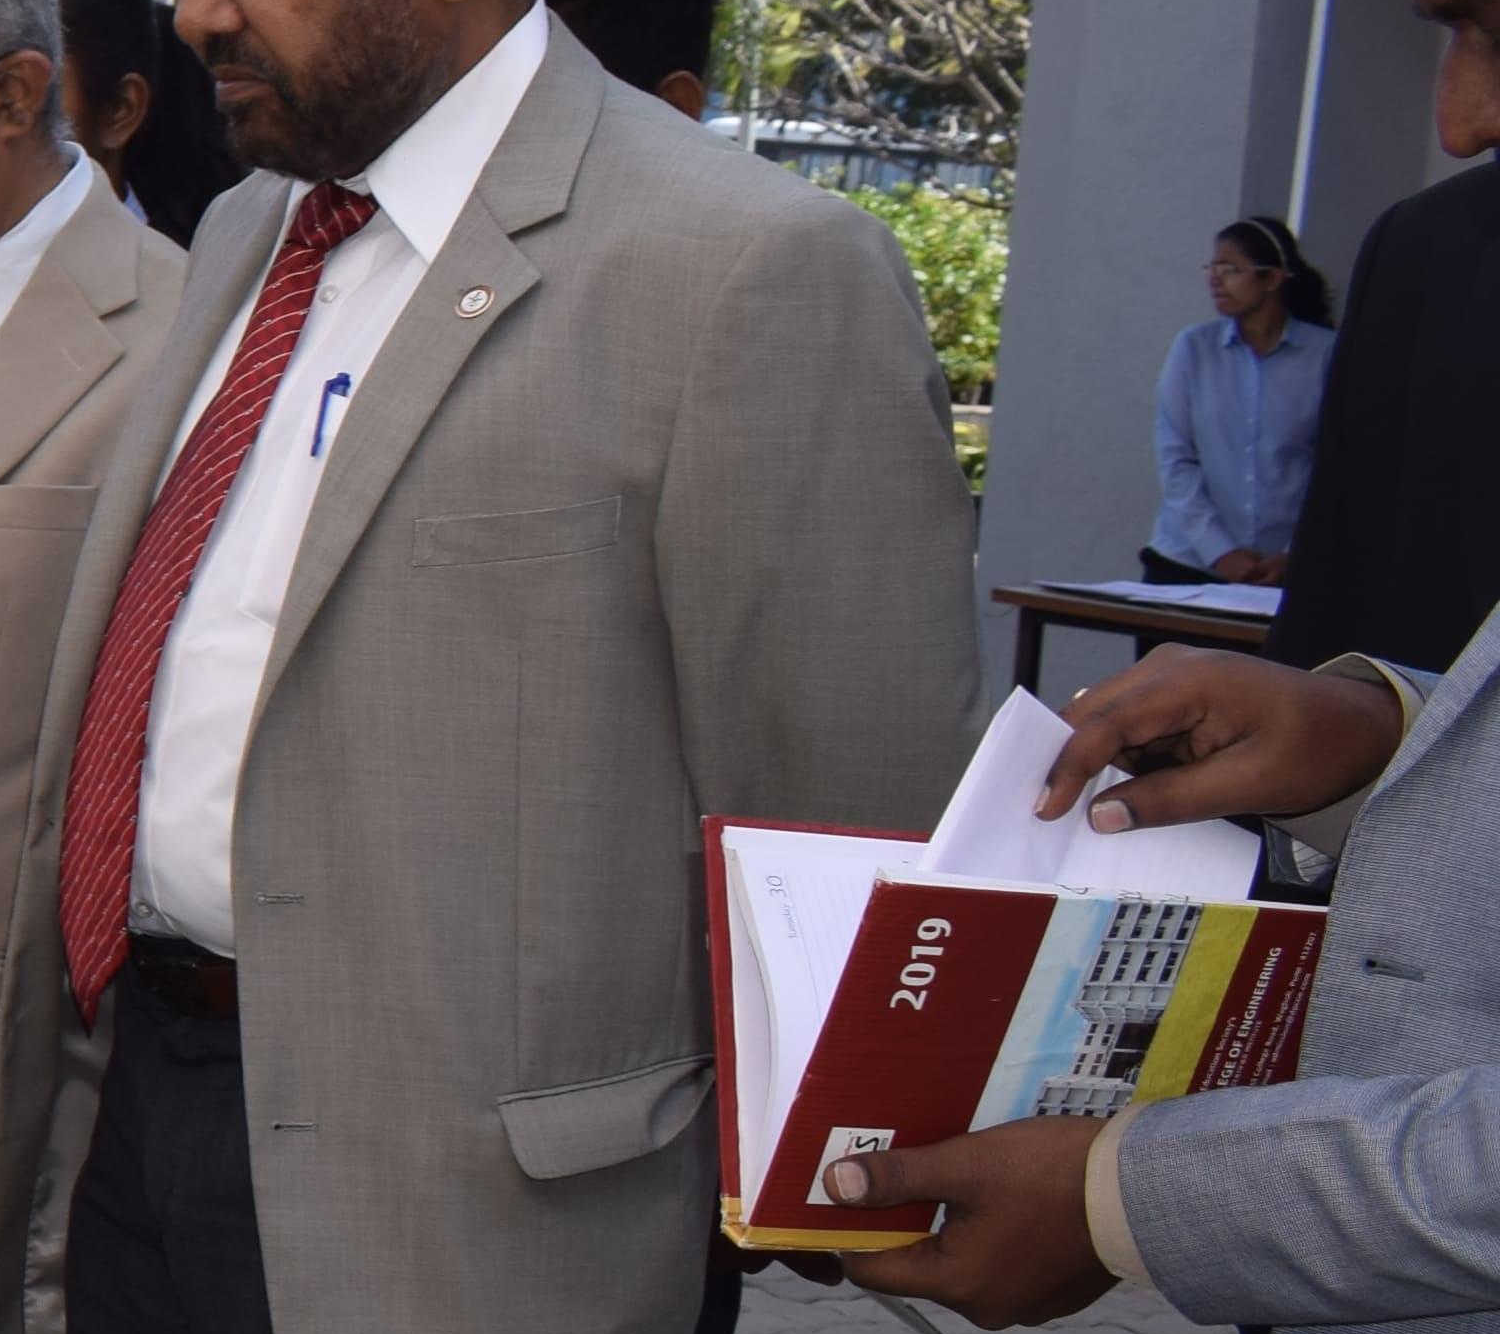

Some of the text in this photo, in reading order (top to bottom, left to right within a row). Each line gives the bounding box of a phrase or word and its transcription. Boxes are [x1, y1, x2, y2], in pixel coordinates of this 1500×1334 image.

[766, 875, 788, 899] 30
[889, 918, 952, 1011] 2019
[1228, 1039, 1245, 1061] OF
[1237, 947, 1282, 1038] ENGINEERING
